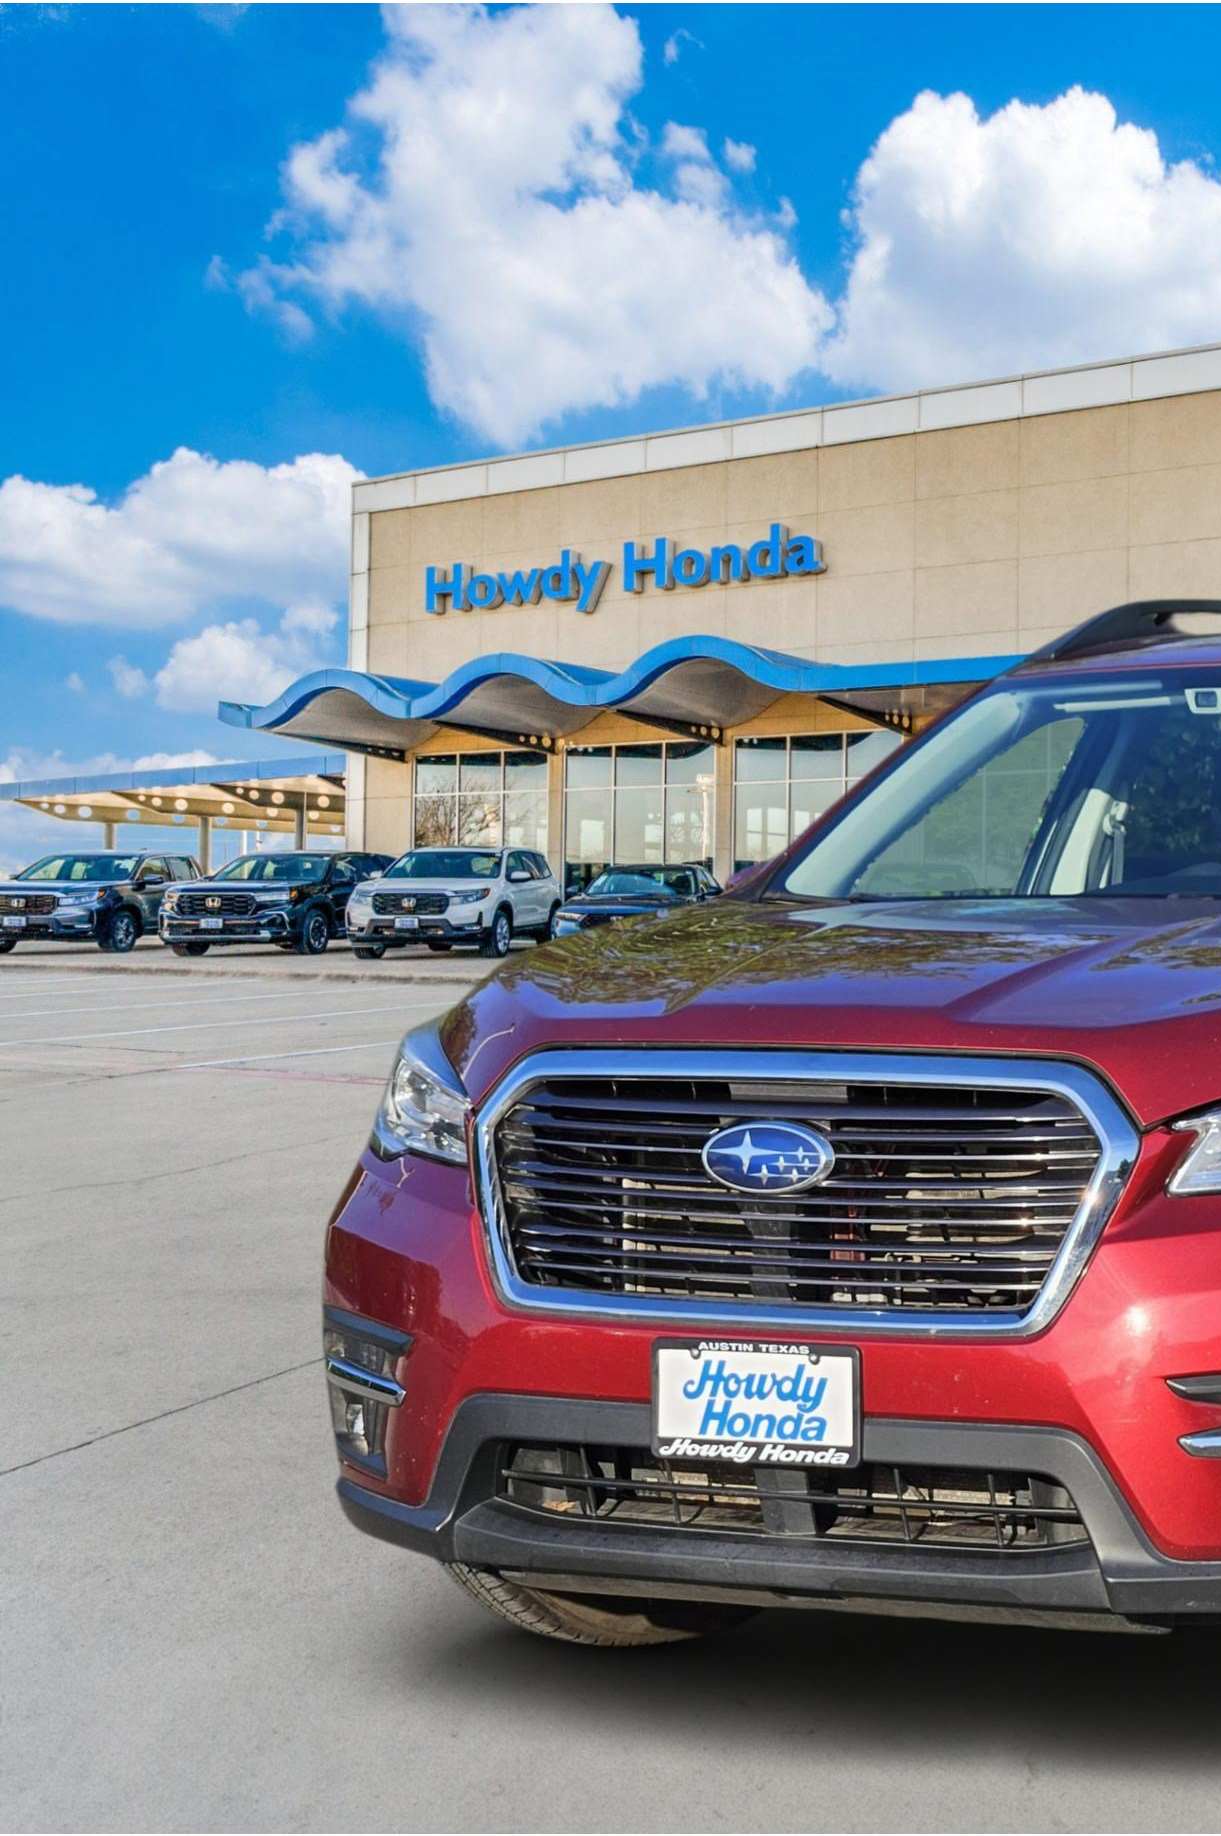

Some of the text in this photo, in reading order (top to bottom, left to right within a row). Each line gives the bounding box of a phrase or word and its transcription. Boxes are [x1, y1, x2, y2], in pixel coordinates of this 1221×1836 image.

[425, 523, 828, 615] Howdy Honda
[698, 1341, 810, 1355] AUSTIN TEXAS
[683, 1360, 828, 1413] Howdy
[698, 1399, 827, 1441] Honda
[659, 1439, 849, 1465] Howdy Honda
